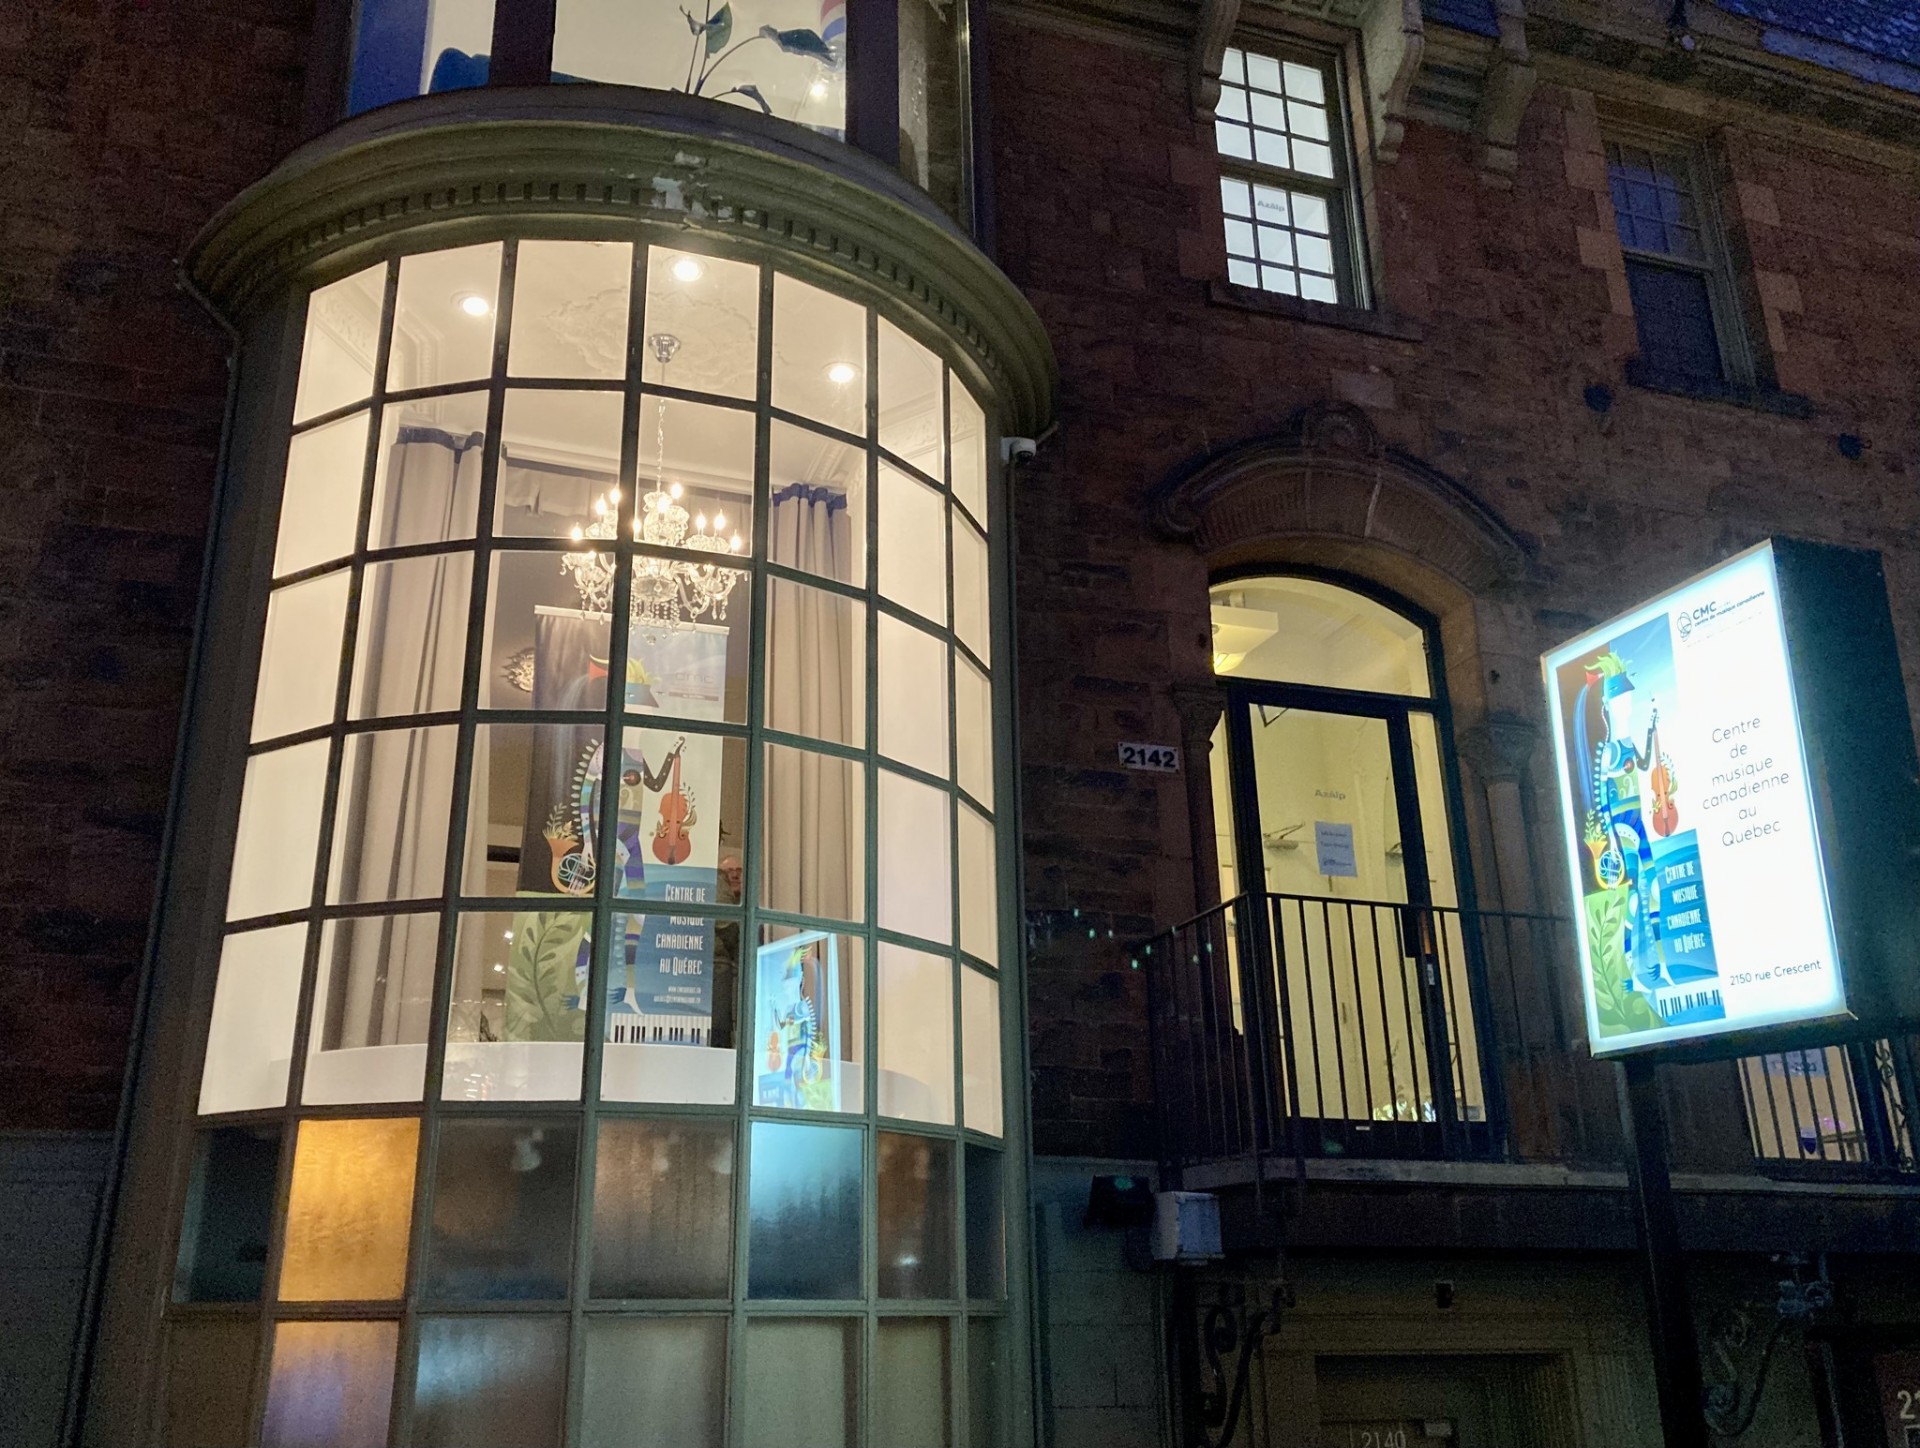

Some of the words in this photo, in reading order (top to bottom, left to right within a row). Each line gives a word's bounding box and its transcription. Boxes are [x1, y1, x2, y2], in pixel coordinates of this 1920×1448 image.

[1692, 601, 1717, 620] CMC
[1716, 605, 1736, 616] musique
[1736, 591, 1765, 607] canadienne
[1711, 718, 1761, 743] Centre
[1123, 746, 1176, 768] 2142
[1729, 743, 1748, 759] de
[1711, 757, 1773, 787] musique
[1702, 772, 1790, 810] canadienne
[1738, 806, 1757, 820] au
[1721, 820, 1781, 847] Quebec
[664, 883, 694, 903] CENTRE
[695, 887, 706, 903] DE
[1672, 884, 1699, 905] MUSIQUE
[669, 915, 705, 927] MUSIQUE
[655, 933, 704, 951] CANADIENNE
[659, 958, 671, 975] AU
[672, 956, 703, 977] QUÉBEC
[1729, 972, 1752, 986] 2150
[1755, 971, 1771, 980] rue
[1773, 959, 1822, 977] Crescent
